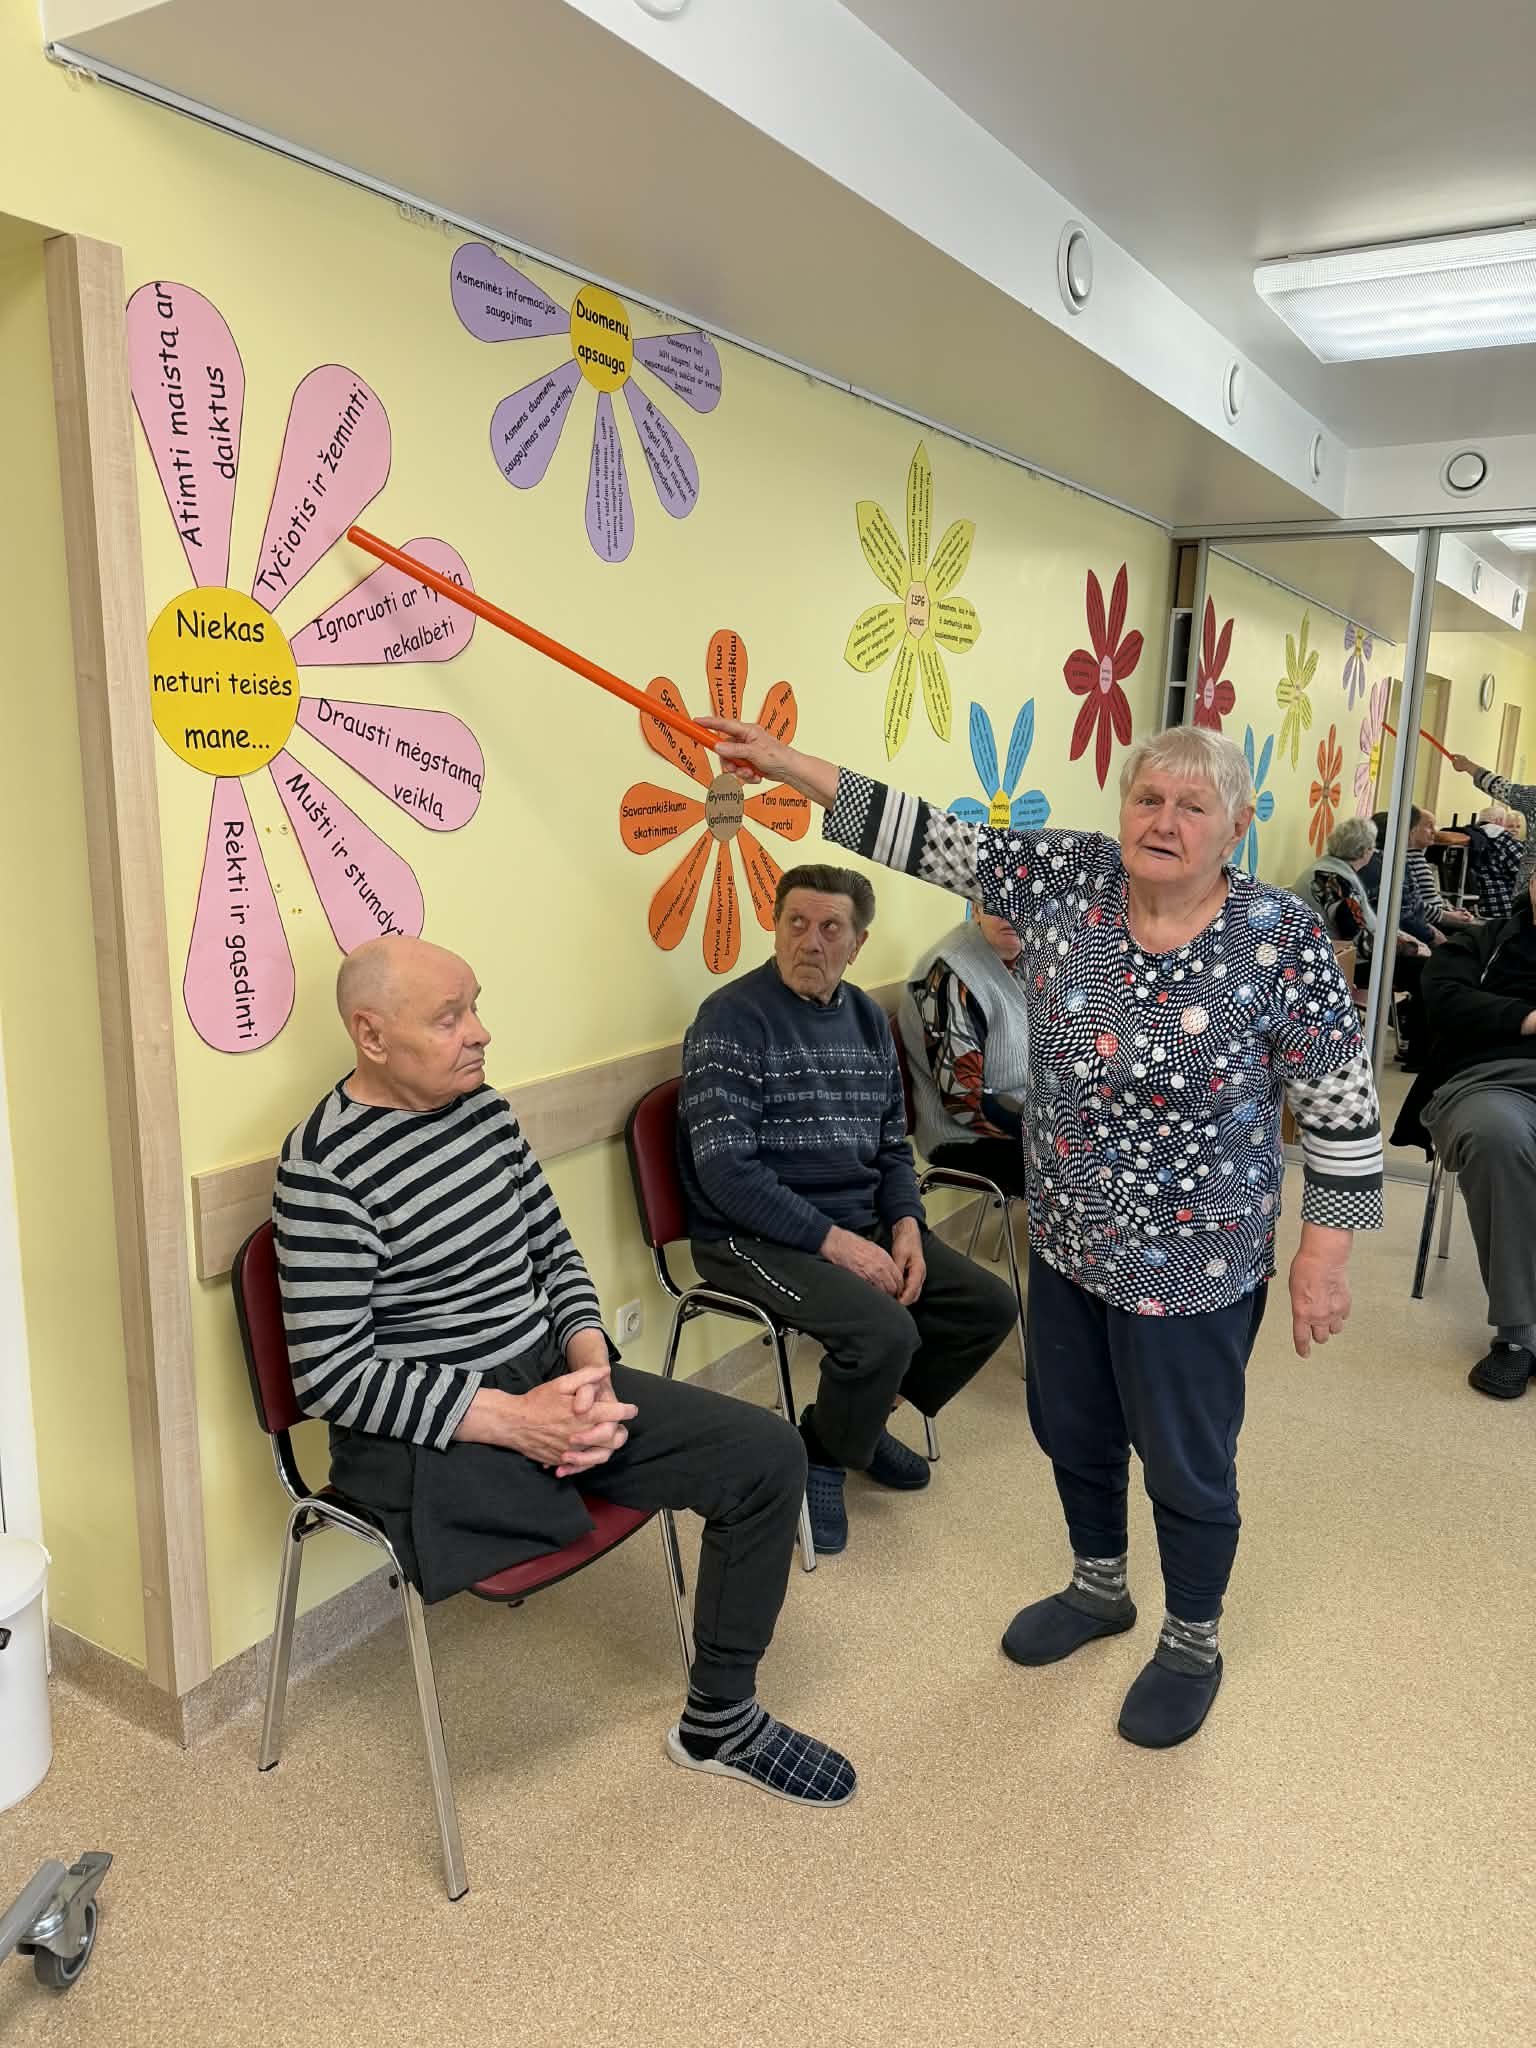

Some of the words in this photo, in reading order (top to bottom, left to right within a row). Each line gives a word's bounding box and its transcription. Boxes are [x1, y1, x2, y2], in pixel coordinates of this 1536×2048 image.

[155, 283, 173, 318] ar
[457, 271, 503, 296] Asmeninės
[506, 287, 556, 315] informacijos
[486, 304, 532, 328] saugojimas
[576, 300, 629, 341] Duomenų
[578, 345, 624, 375] apsauga
[158, 327, 189, 436] maistą
[208, 366, 235, 479] daiktus
[317, 383, 368, 474] žeminti
[505, 413, 528, 444] Asmens
[528, 379, 555, 414] duomenų
[505, 429, 539, 475] saugojimas
[538, 415, 550, 431] nuo
[550, 386, 572, 416] svetimų
[642, 419, 660, 453] negali
[315, 473, 327, 497] ir
[673, 454, 696, 498] duomenys
[171, 448, 202, 547] Atimti
[257, 498, 317, 591] Tyčiotis
[177, 610, 265, 643] Niekas
[313, 597, 398, 643] Ignoruoti
[401, 589, 418, 608] ar
[384, 617, 455, 662] nekalbėti
[153, 671, 220, 693] neturi
[229, 673, 292, 696] teisės
[779, 687, 792, 706] mes
[185, 727, 270, 749] mane...
[318, 698, 391, 748] Drausti
[396, 736, 482, 793] mėgstamą
[286, 774, 337, 839] Mušti
[332, 838, 347, 858] ir
[394, 784, 444, 822] veiklą
[623, 802, 687, 817] Savarankiškumo
[761, 793, 777, 806] Tavo
[778, 795, 808, 808] nuomonė
[634, 825, 678, 839] skatinimas
[224, 821, 248, 893] Rėkti
[715, 861, 723, 924] dalyvavimas
[231, 904, 250, 925] ir
[713, 930, 721, 970] Aktyvus
[226, 935, 257, 1039] gąsdinti
